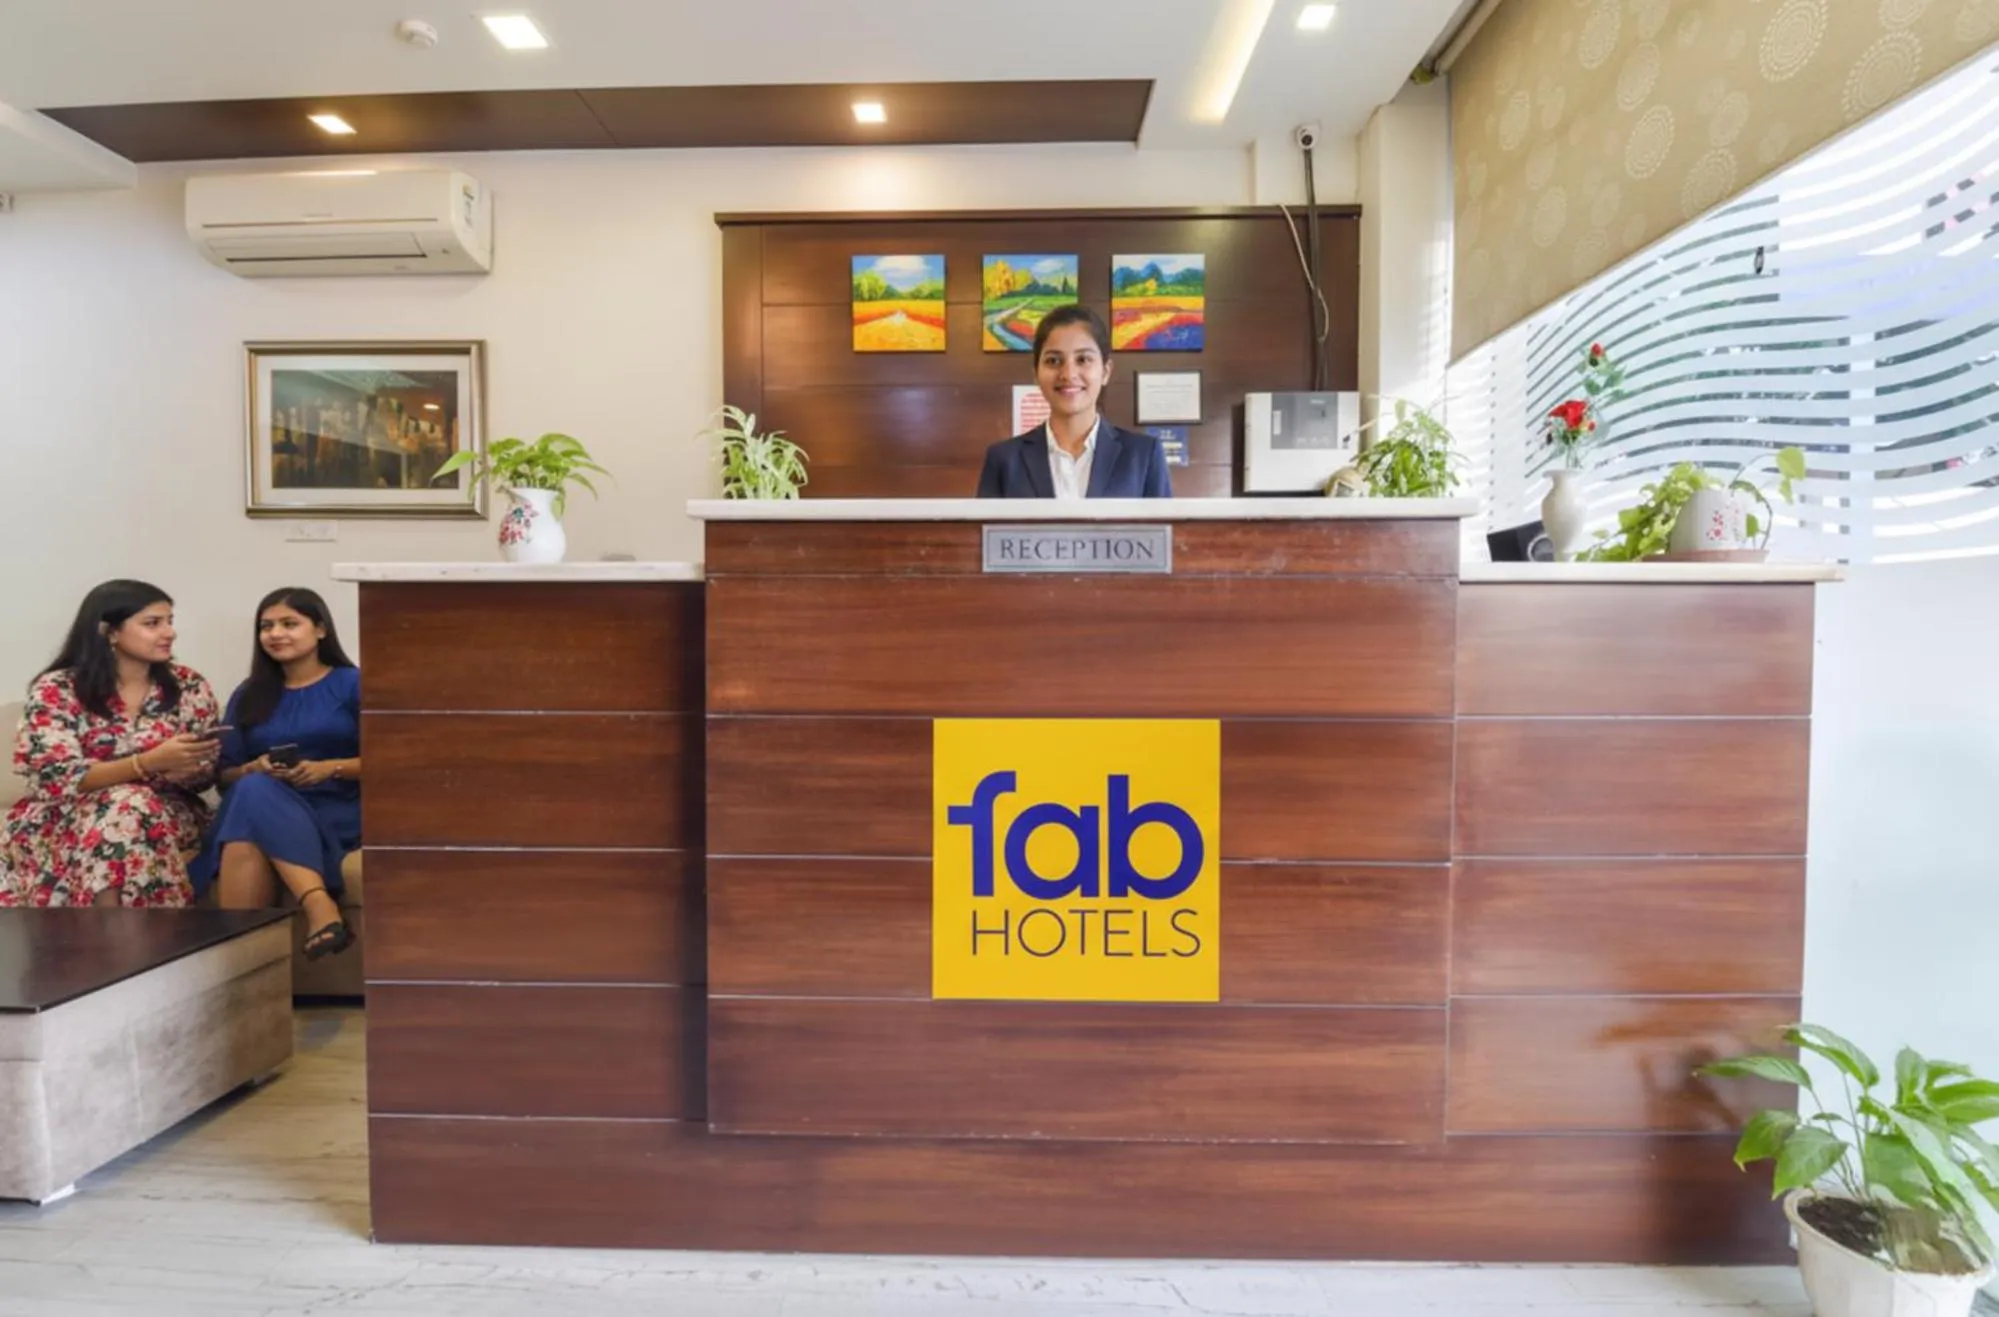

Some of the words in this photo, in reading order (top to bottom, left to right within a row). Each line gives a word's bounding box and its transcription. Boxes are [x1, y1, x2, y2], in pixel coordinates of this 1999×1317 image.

[1000, 538, 1155, 560] RECEPTION
[947, 770, 1205, 900] fab
[971, 908, 1201, 957] HOTELS
